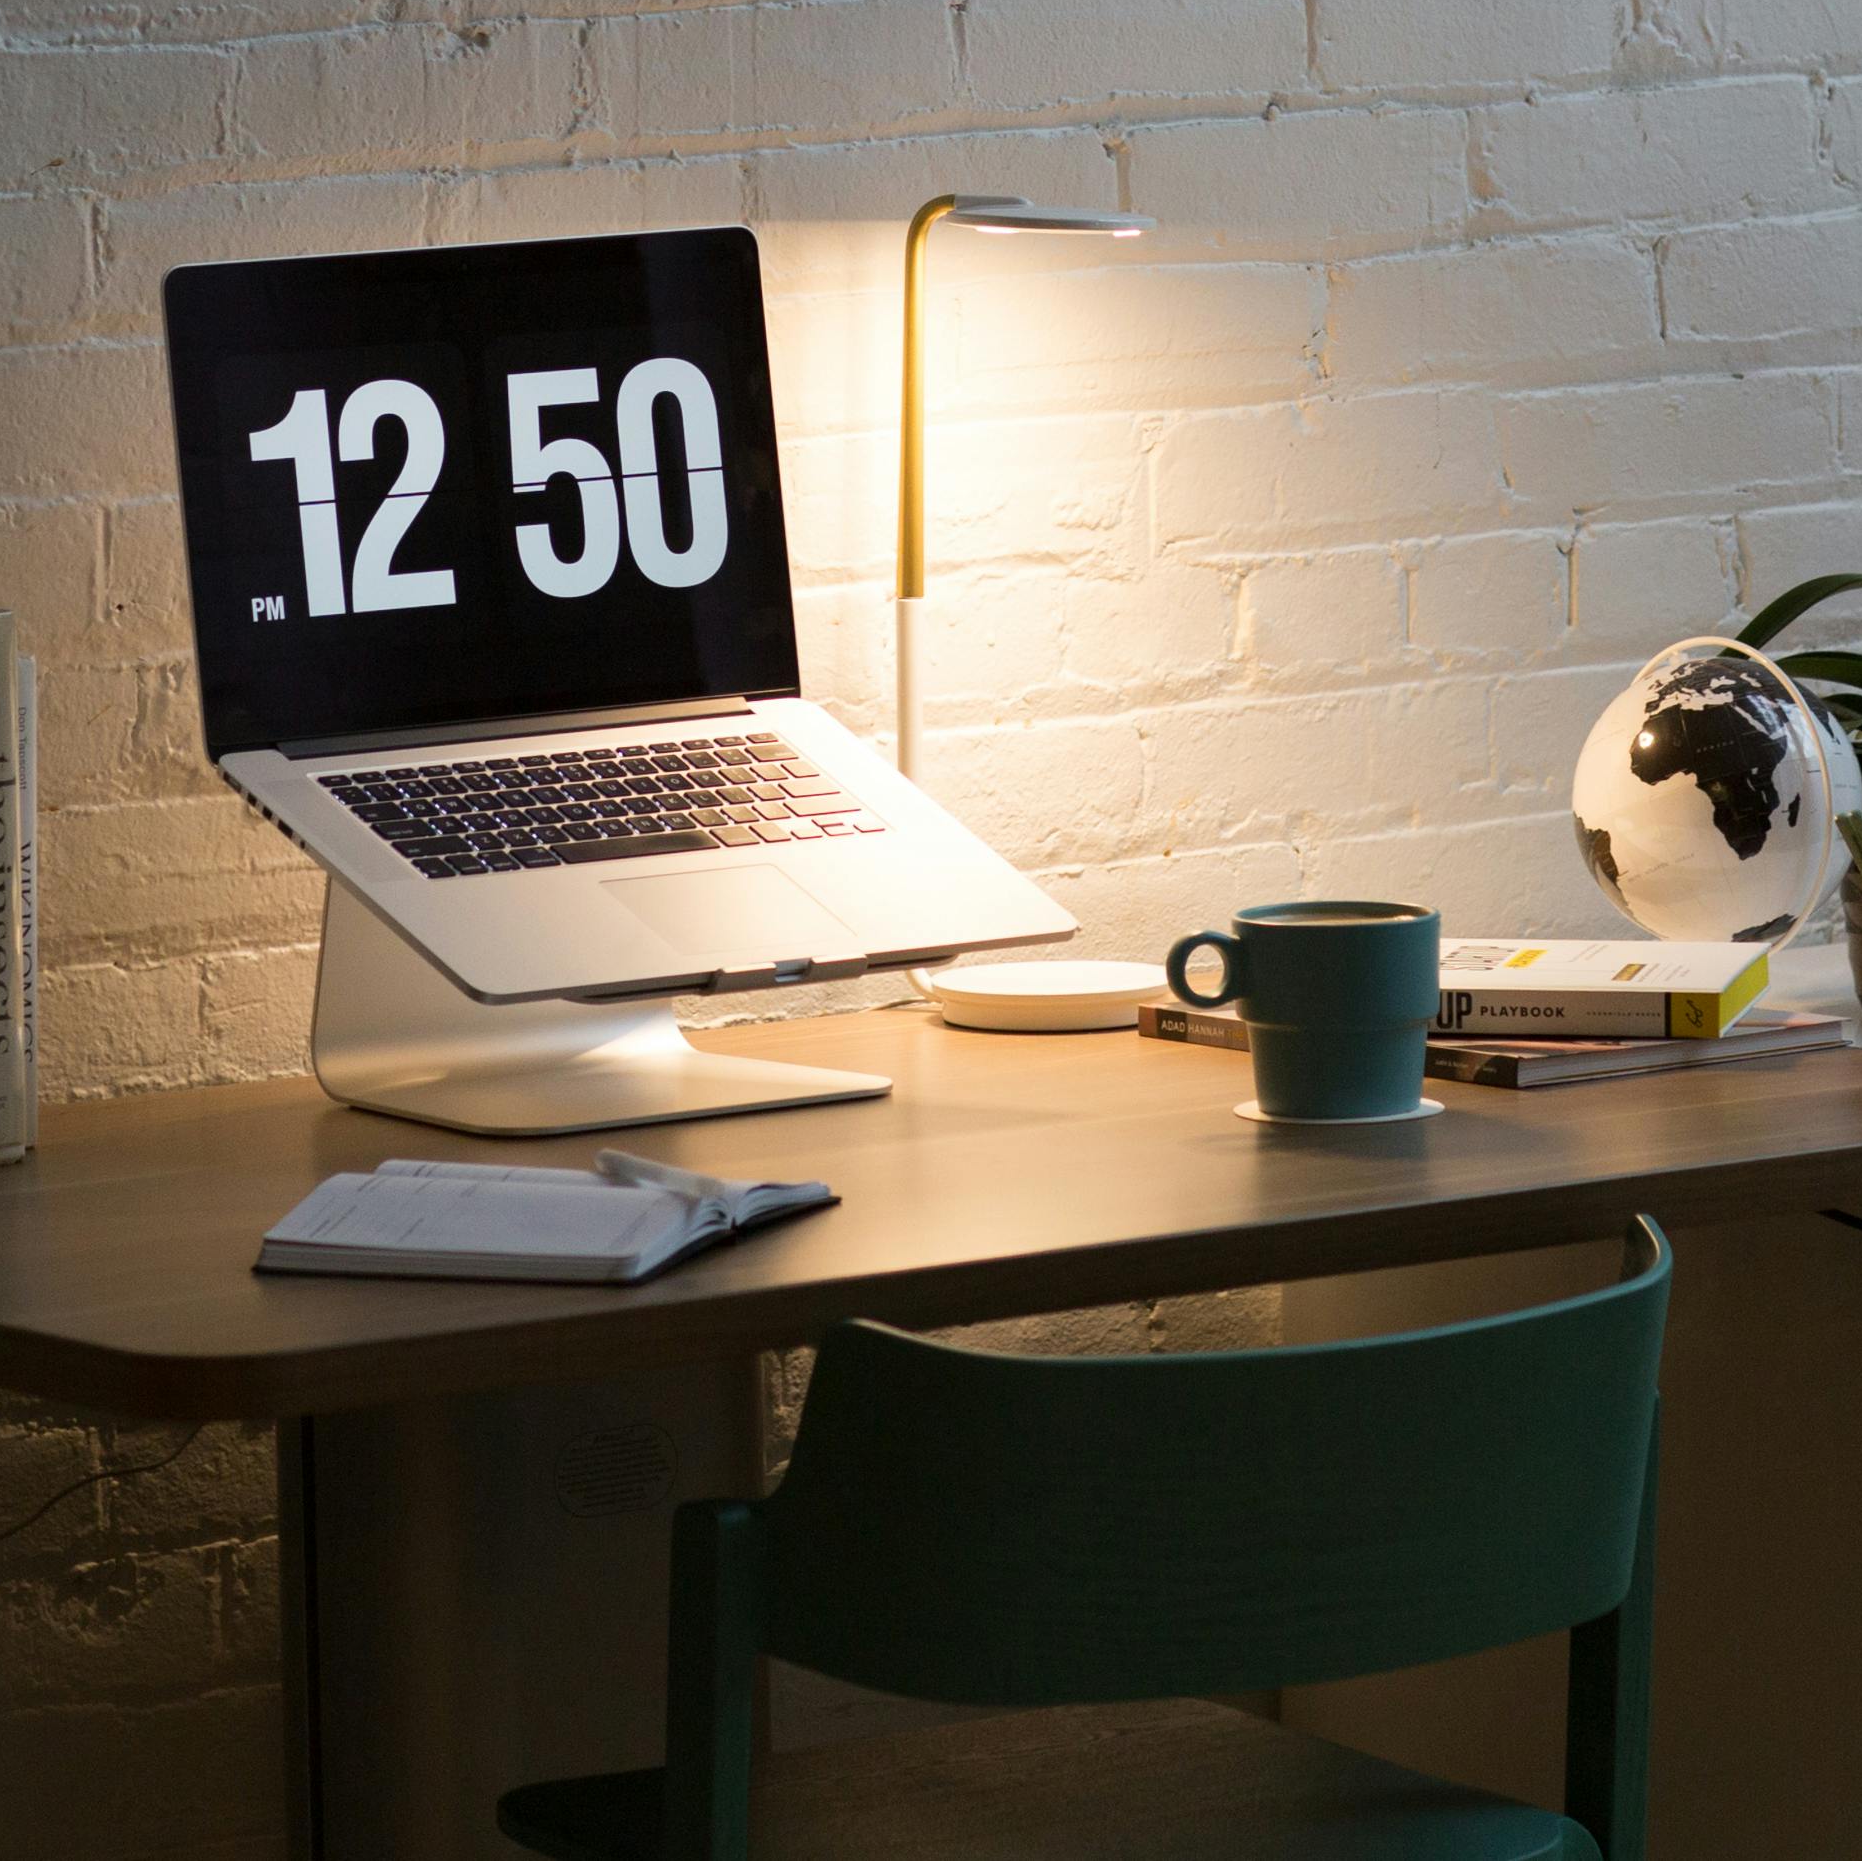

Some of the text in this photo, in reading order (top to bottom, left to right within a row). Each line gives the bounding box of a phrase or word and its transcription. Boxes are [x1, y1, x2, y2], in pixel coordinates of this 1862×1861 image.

[249, 357, 728, 616] 12 50
[251, 596, 285, 621] PM
[19, 707, 27, 731] Don
[1435, 991, 1565, 1030] UP PLAYBOOK
[1161, 1020, 1186, 1033] ADAD
[1188, 1024, 1225, 1037] HANNAH
